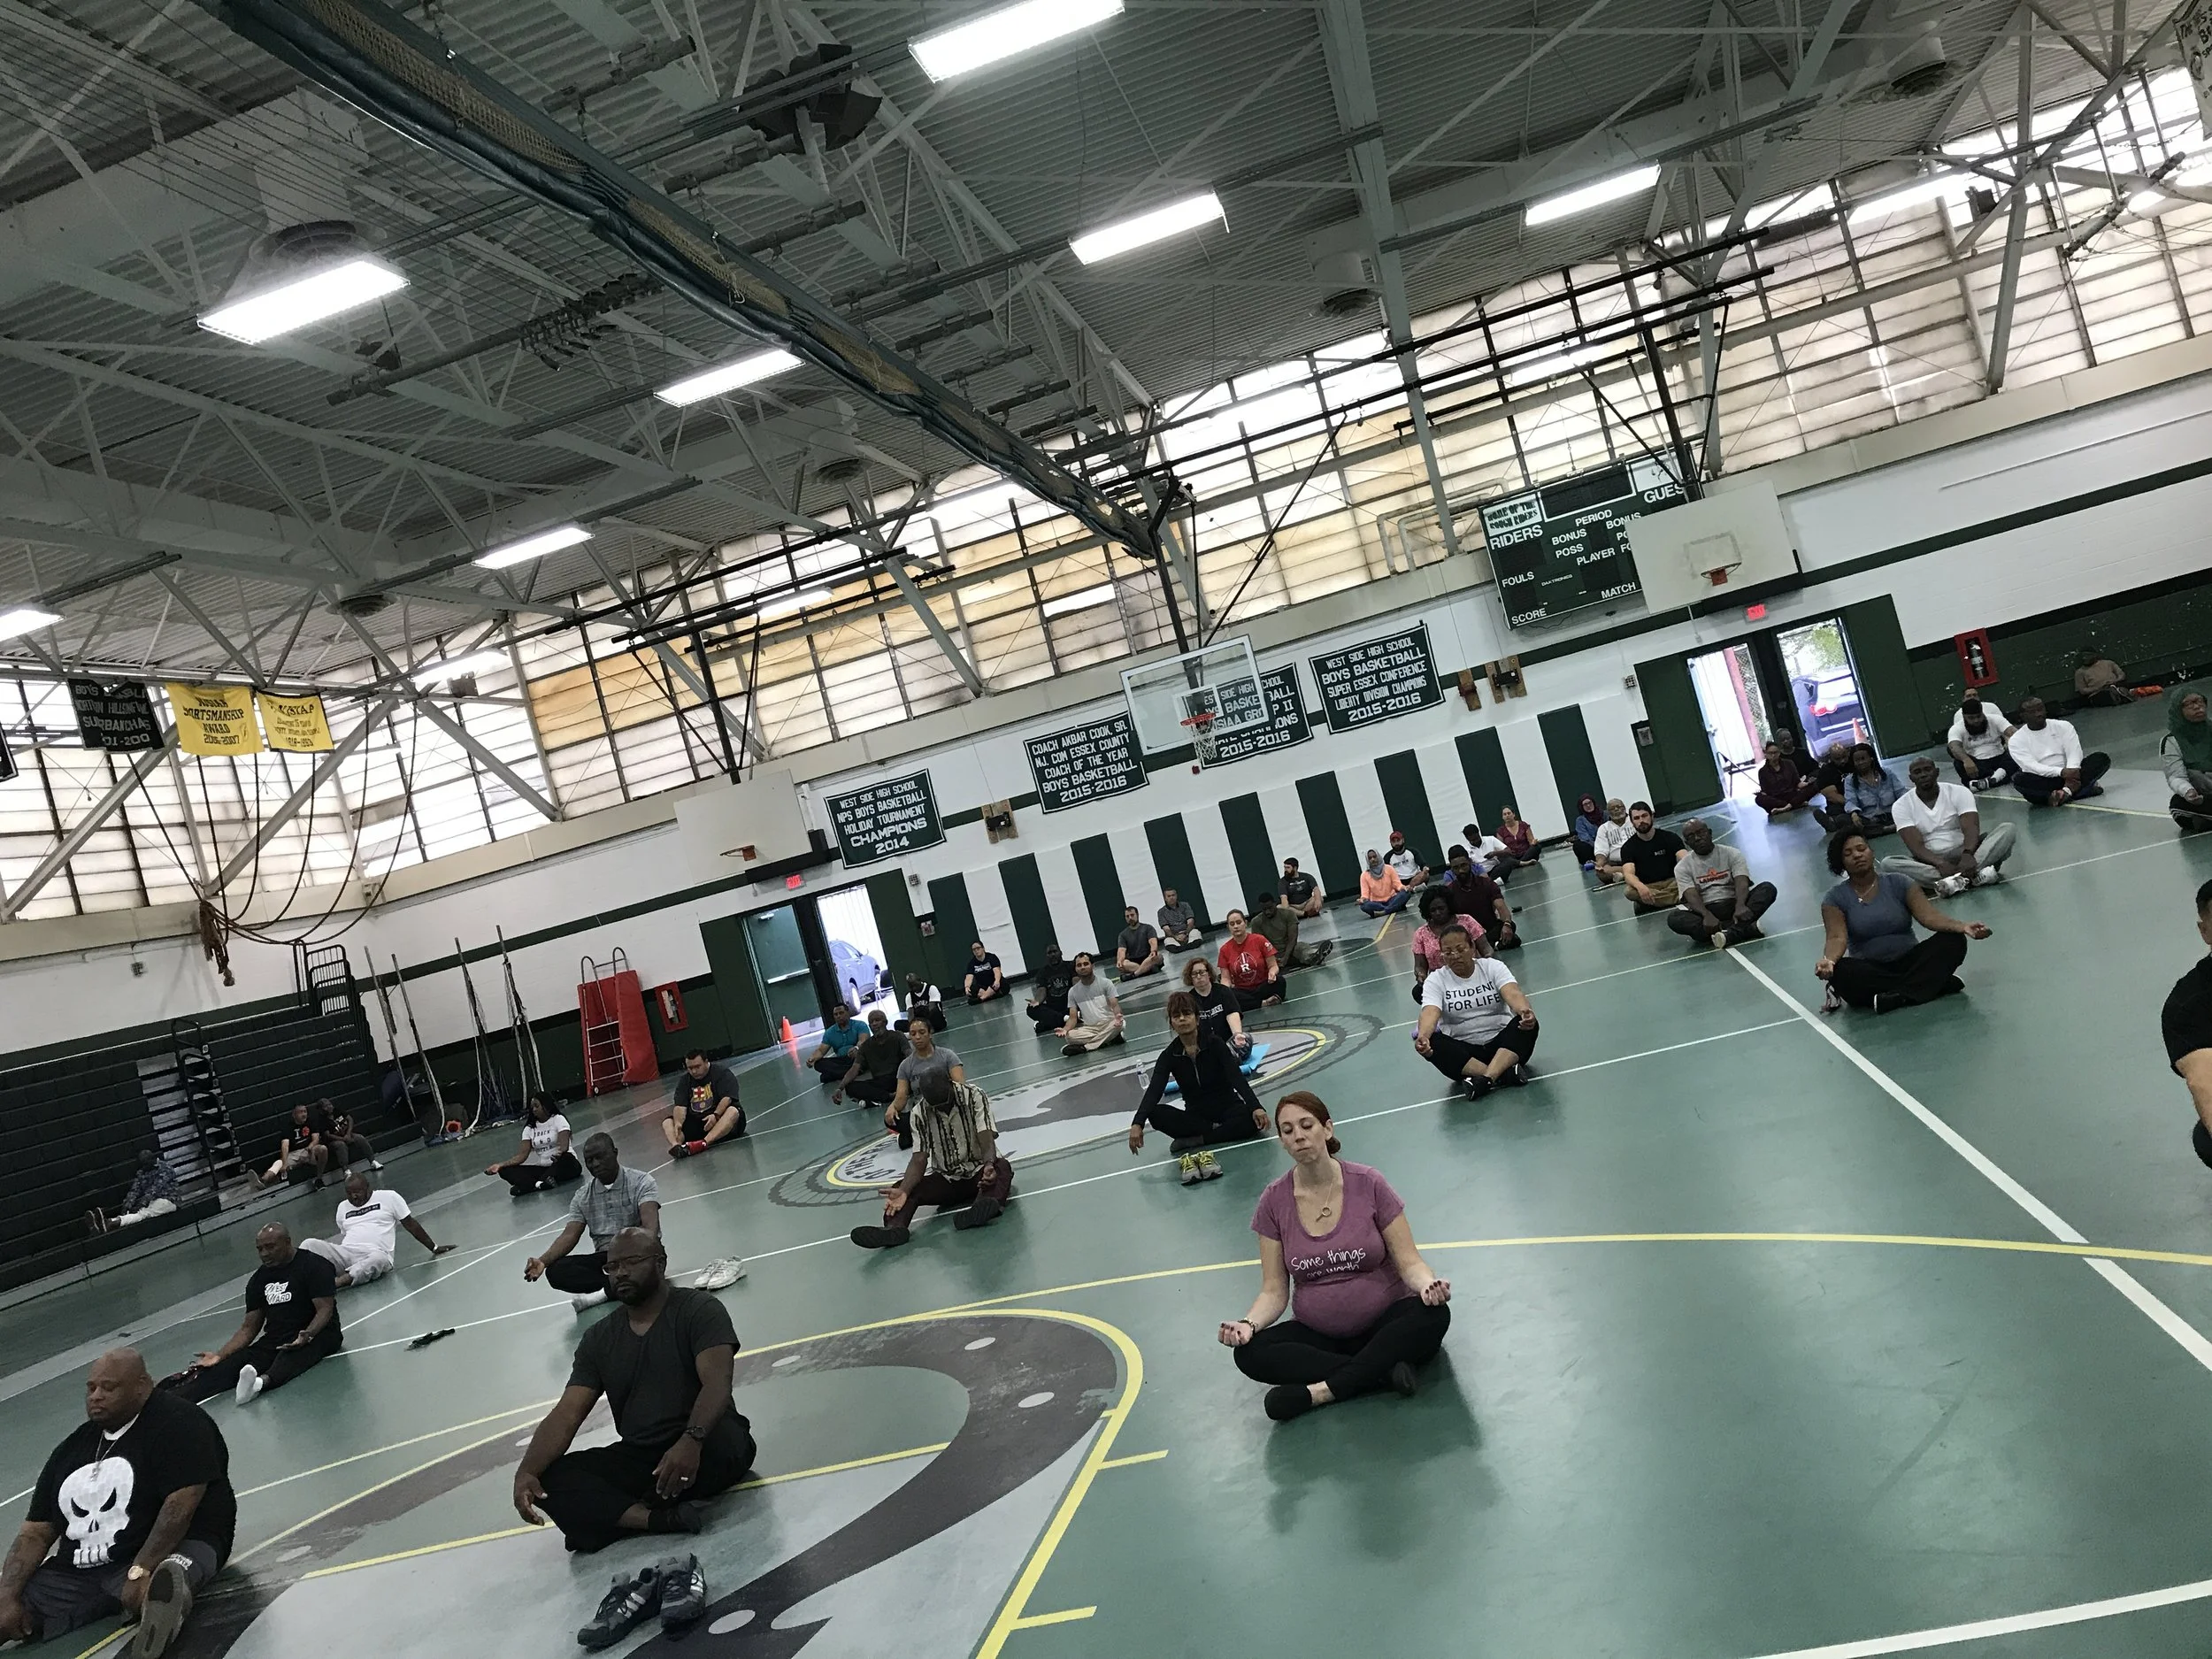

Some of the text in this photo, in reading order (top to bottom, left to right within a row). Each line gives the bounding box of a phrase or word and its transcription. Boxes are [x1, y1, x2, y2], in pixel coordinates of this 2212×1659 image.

[1643, 481, 1684, 503] GUES
[1575, 509, 1612, 526] PERIOD
[1489, 524, 1543, 550] RIDERS
[1551, 528, 1587, 546] BONUS
[1555, 543, 1584, 559] POSS
[1576, 547, 1616, 566] PLAYER
[1502, 572, 1535, 588] FOULS
[1601, 582, 1637, 599] MATCH
[1511, 607, 1547, 625] SCORE
[1321, 647, 1426, 685] BOYS BASKETBALL
[1325, 637, 1415, 670] WEST SIDE HIGH SCHOOL
[1220, 688, 1237, 701] SIDE
[1239, 682, 1255, 695] HIGH
[1261, 675, 1285, 689] CHOOL
[1327, 660, 1427, 698] SUPER ESSEX CONFERENCE
[1225, 685, 1295, 713] BASKEBALL
[1244, 703, 1279, 721] GROP
[1283, 699, 1294, 711] II
[1348, 692, 1423, 722] 2015-2016
[1032, 720, 1128, 756] COACH AKBAR COOK, SR.
[1051, 752, 1068, 764] COM
[1071, 741, 1096, 758] ESSEX
[1099, 733, 1131, 751] COUNTY
[1042, 759, 1138, 793] BOYS BASKETBALL
[1044, 747, 1129, 780] COACH OF THE YEAR
[837, 789, 927, 824] NPS BOYS BASKETBALL
[840, 780, 918, 810] WEST SIDE HIGH SCHOOL
[844, 803, 926, 835] HOLIDAY TOURNAMENT
[850, 817, 927, 848] CHAMPIONS
[874, 835, 910, 855] 2014
[1445, 980, 1495, 1000] STUDENT
[1448, 993, 1502, 1012] FOR LIFE
[1291, 1248, 1366, 1271] Some things
